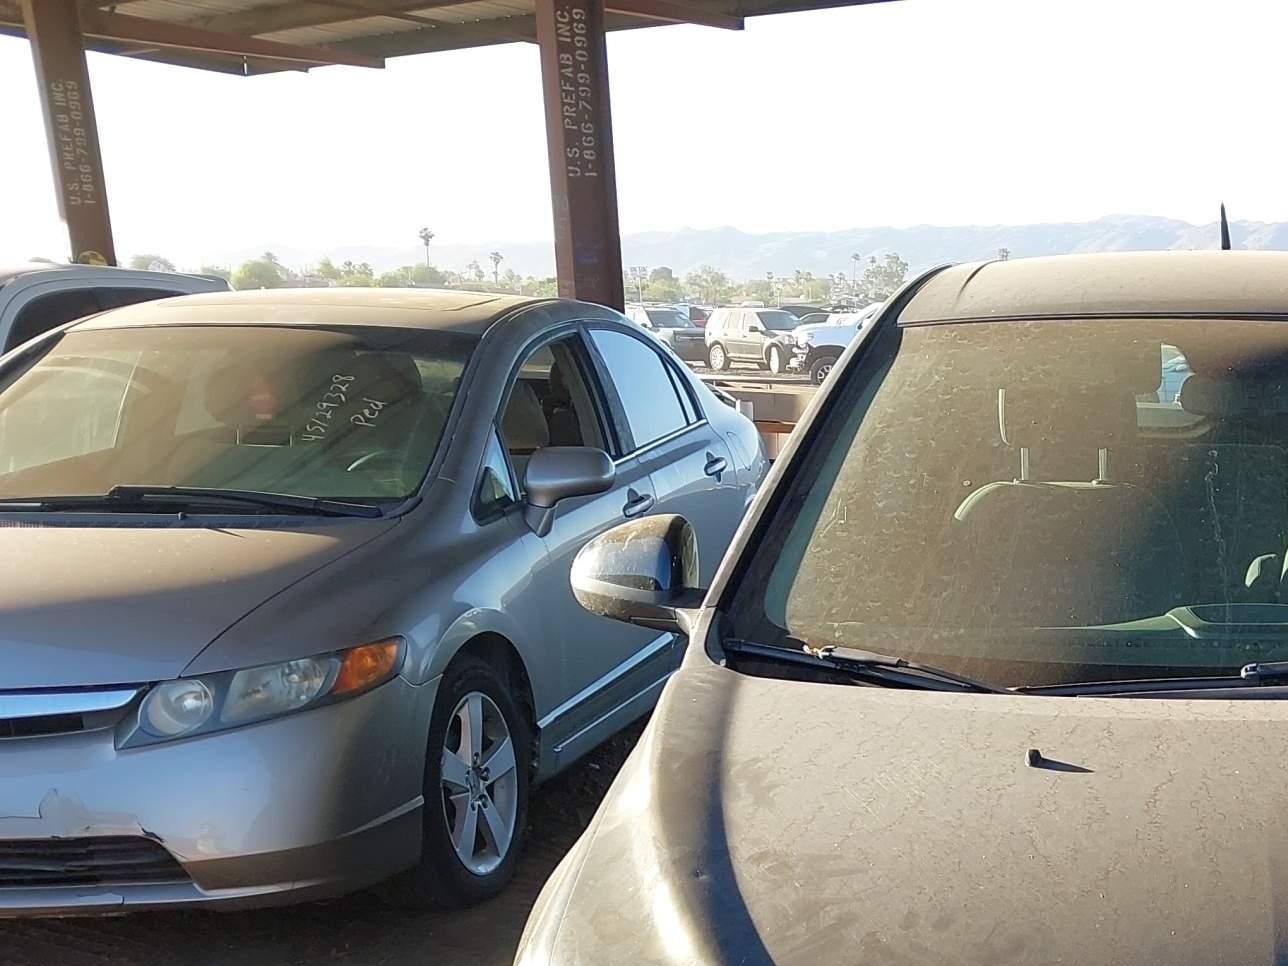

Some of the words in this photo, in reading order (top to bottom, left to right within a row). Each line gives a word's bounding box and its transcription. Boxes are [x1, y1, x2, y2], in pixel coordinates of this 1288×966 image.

[555, 5, 572, 42] INC.
[559, 53, 577, 129] PREFAB
[572, 8, 598, 177] 1-866-799-0969
[56, 114, 77, 170] PREFAB
[567, 142, 581, 177] U.S.
